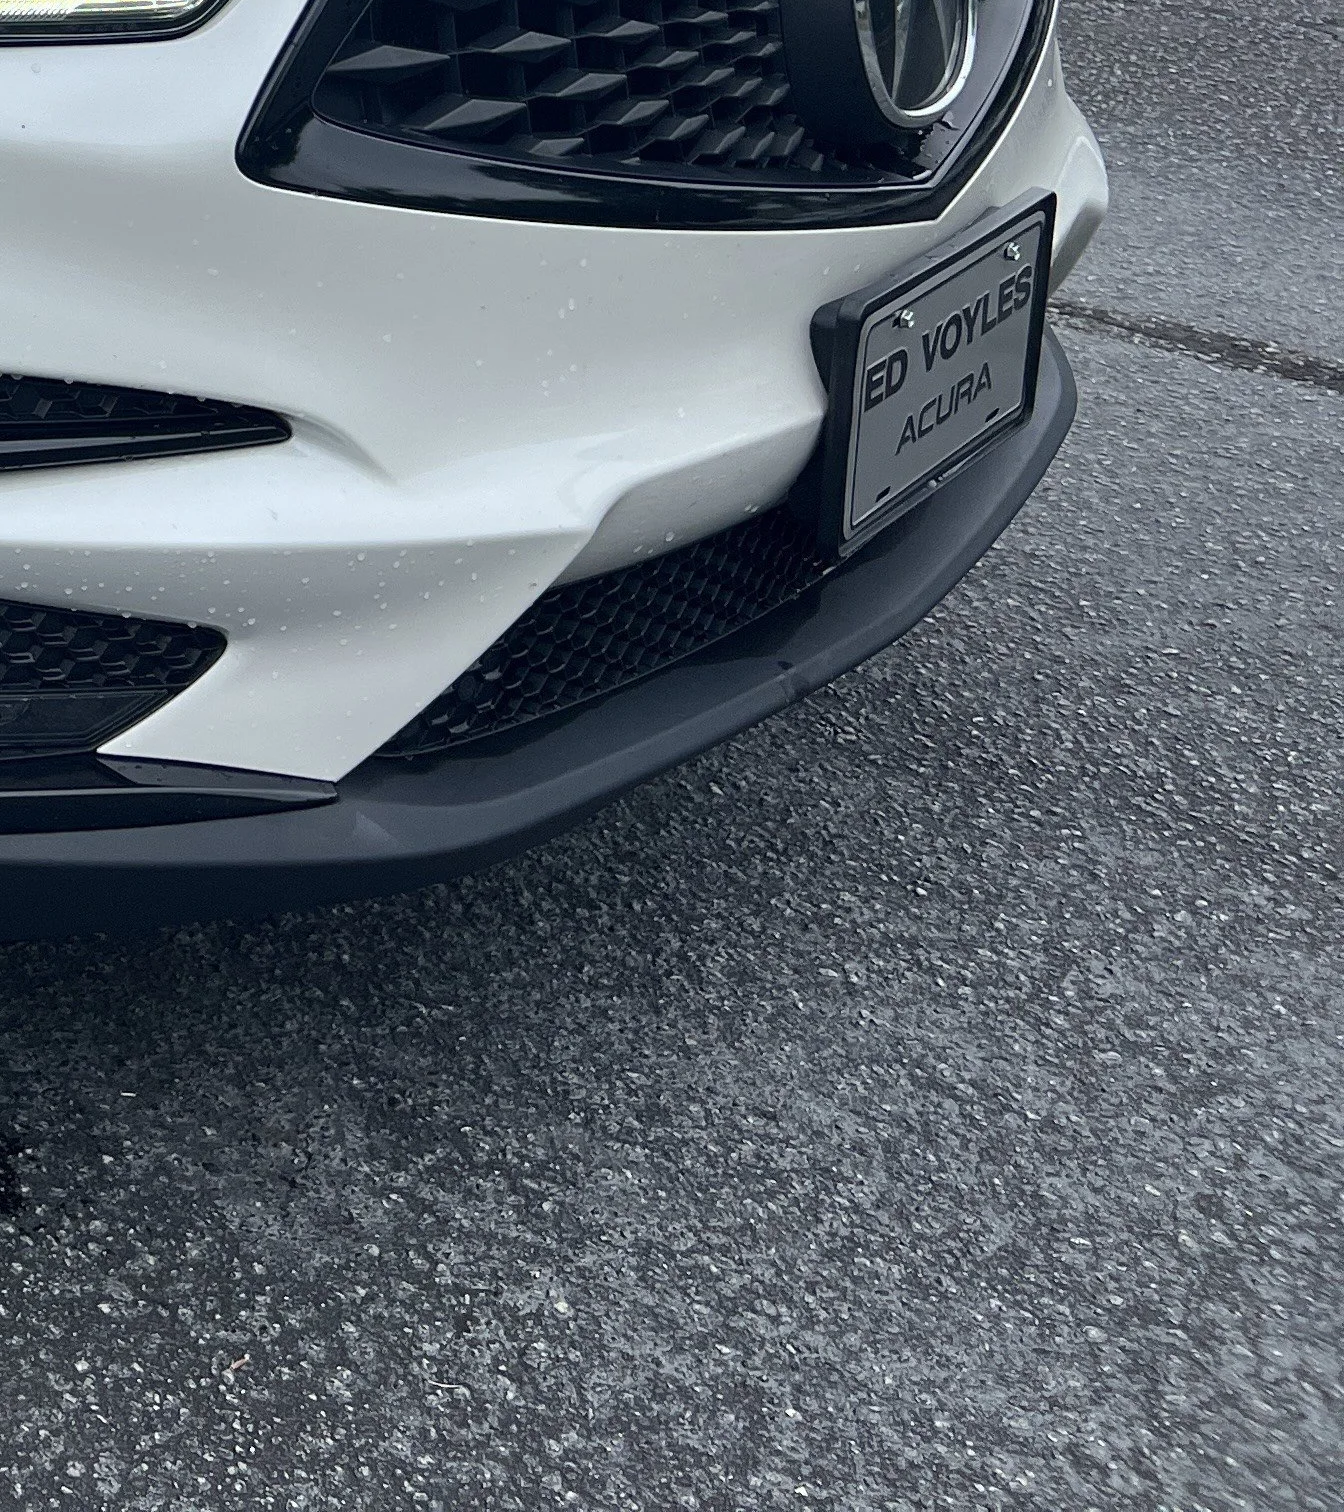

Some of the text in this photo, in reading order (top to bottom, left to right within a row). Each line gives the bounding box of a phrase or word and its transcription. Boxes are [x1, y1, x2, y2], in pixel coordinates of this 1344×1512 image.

[864, 263, 1033, 412] ED VOYLES
[894, 362, 993, 456] ACURA
